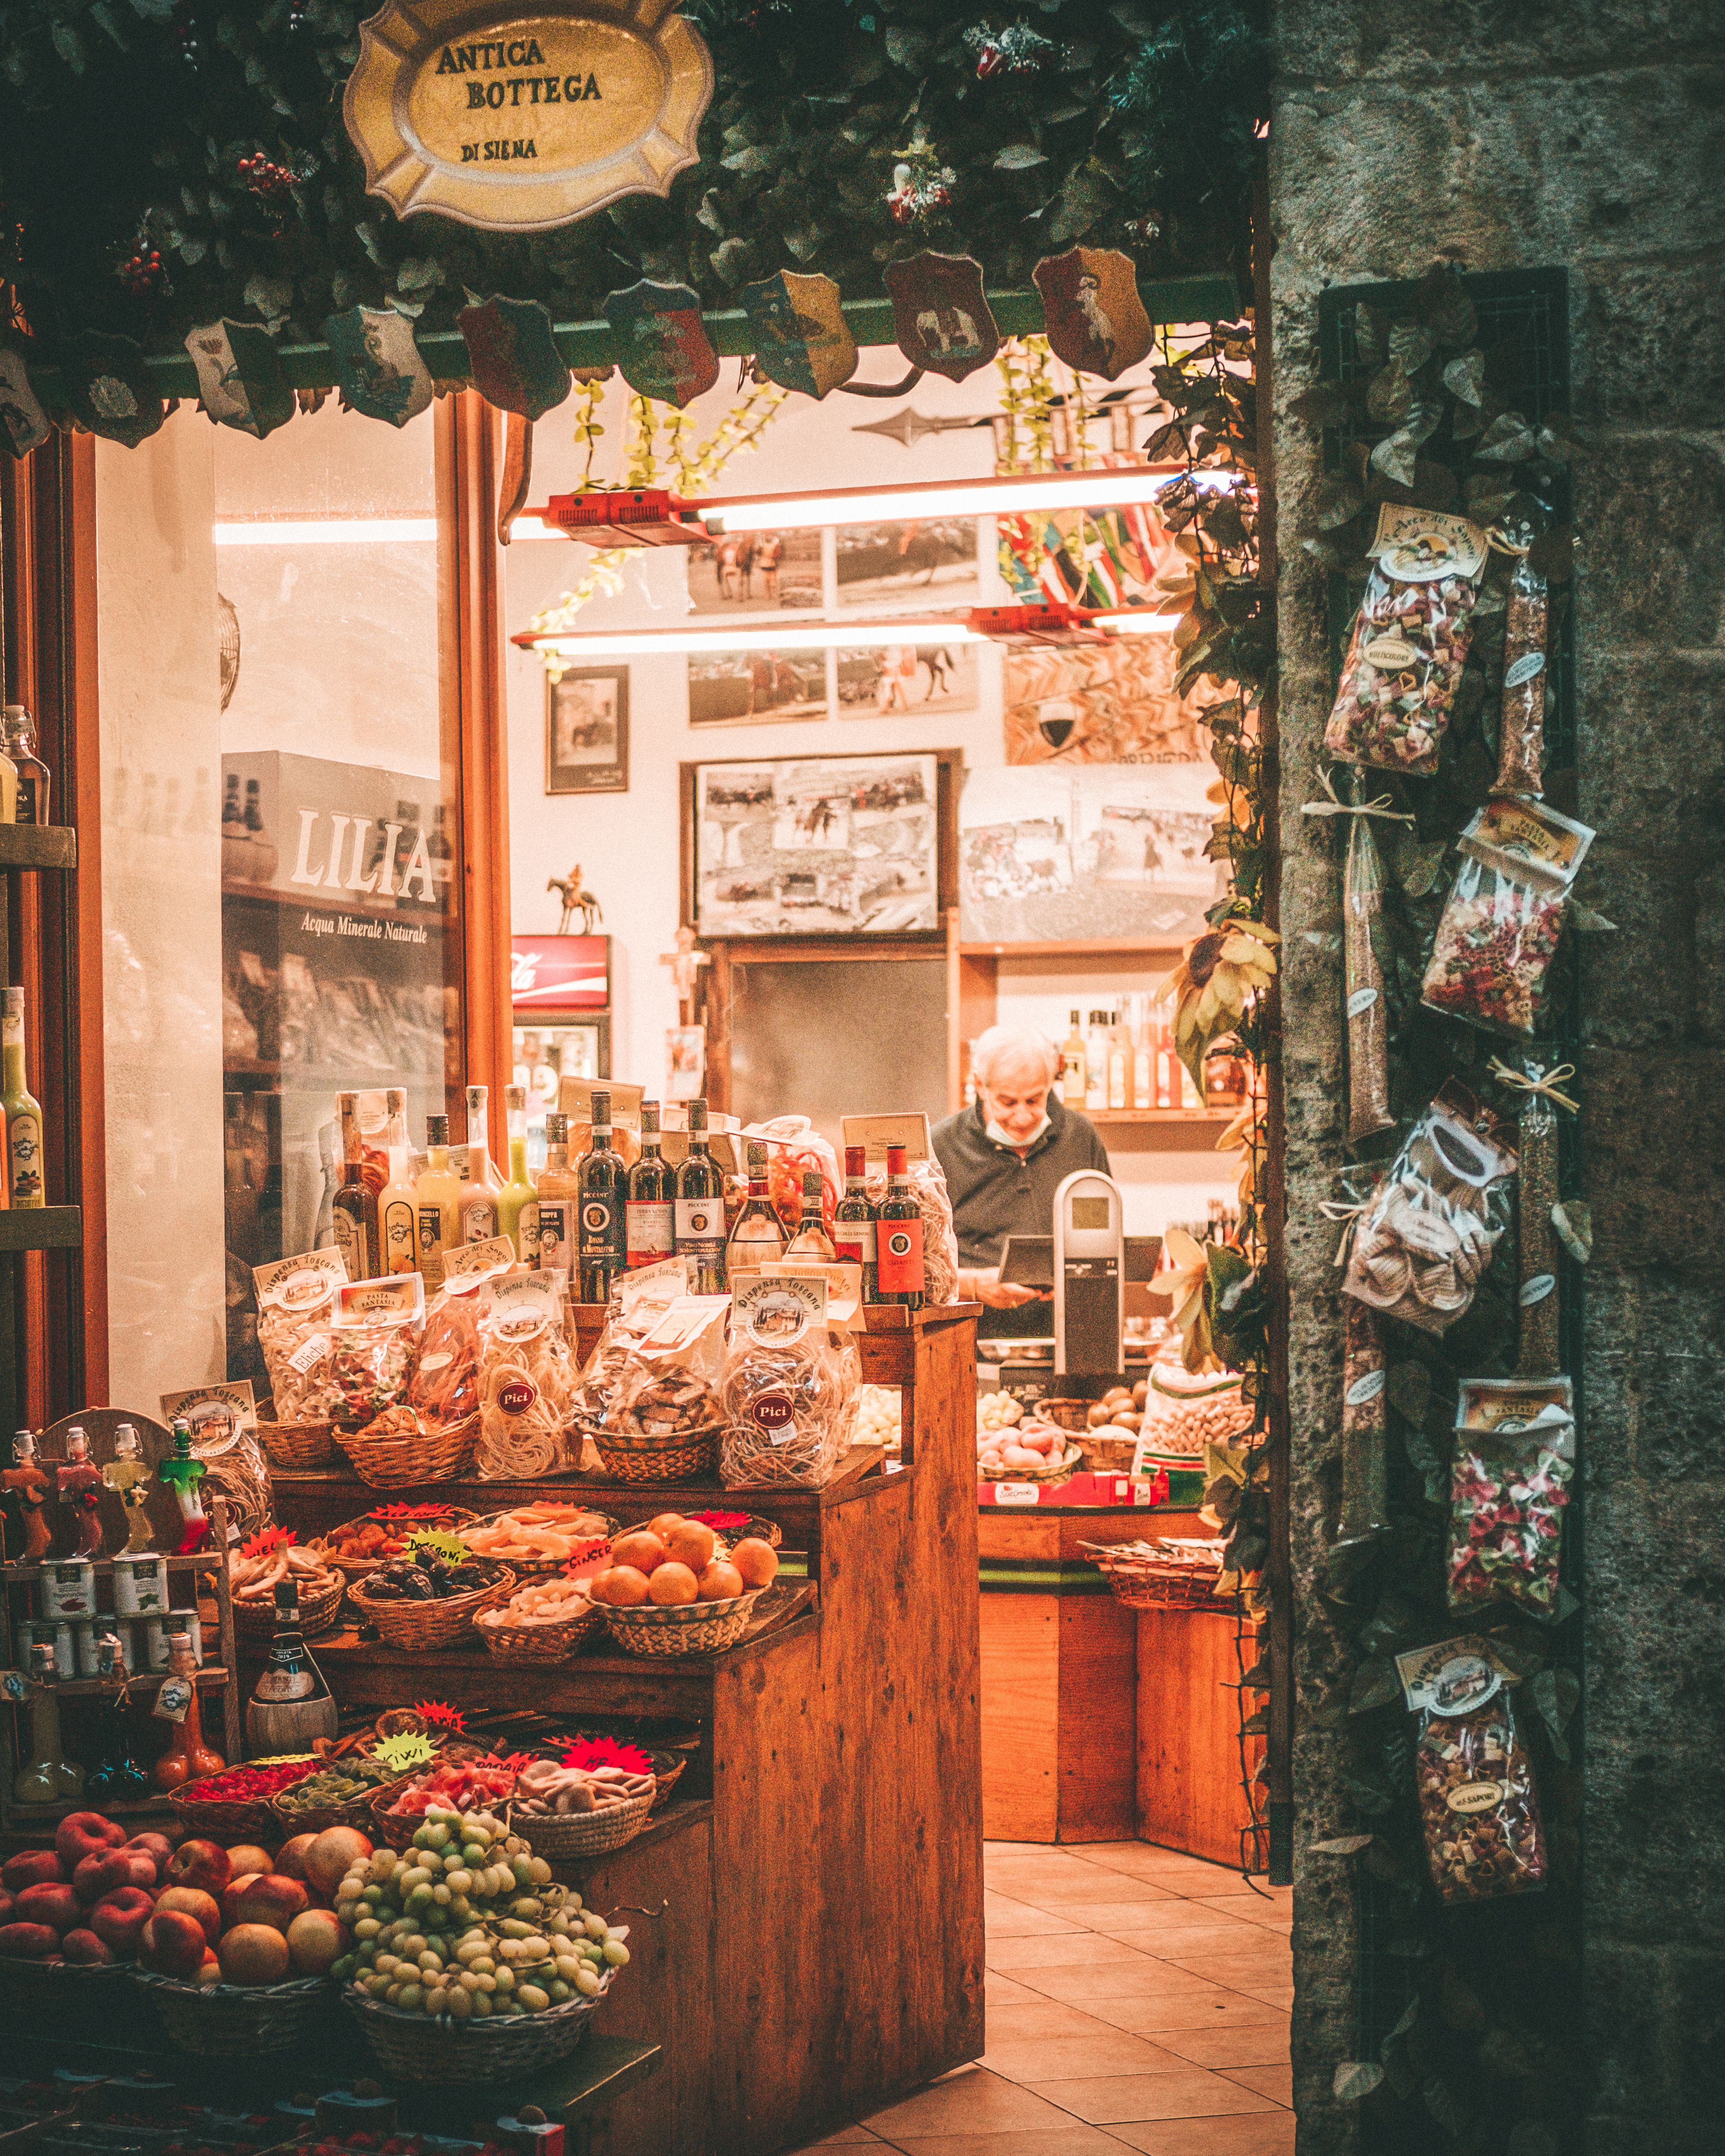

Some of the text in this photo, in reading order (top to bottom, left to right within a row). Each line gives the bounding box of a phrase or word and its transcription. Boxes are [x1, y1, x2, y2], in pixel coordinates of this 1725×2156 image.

[435, 39, 545, 74] ANTICA
[467, 73, 602, 109] BOTTEGA
[461, 139, 538, 162] DI SIENA
[291, 809, 436, 903] LILIA
[301, 911, 427, 944] Acqua Minerale Naturale
[264, 1254, 340, 1294] Dispensa Toscana
[495, 1278, 550, 1300] Dispensa Toscana
[628, 1267, 682, 1291] Dispensa Toscana
[362, 1300, 395, 1308] FANTASIA
[738, 1277, 821, 1310] Dispensa Toscana
[295, 1341, 326, 1370] Eliche
[168, 1386, 250, 1422] Dispensa Toscana
[504, 1392, 528, 1404] Pici
[760, 1406, 788, 1417] Pici
